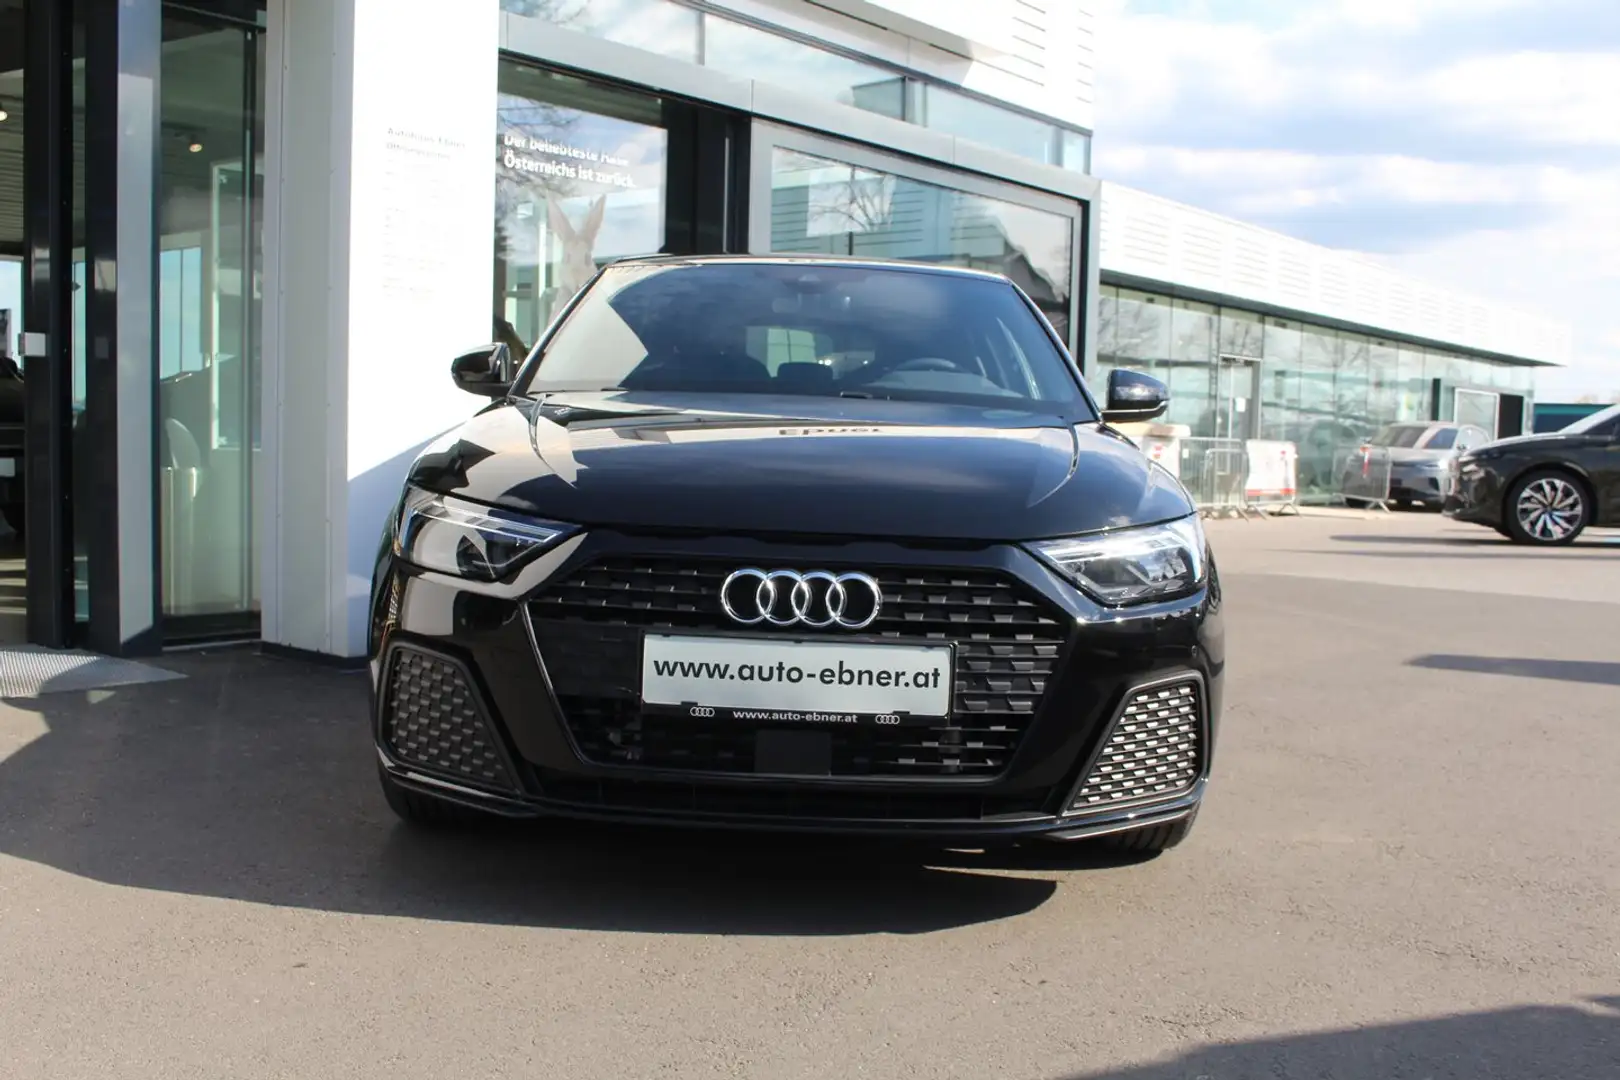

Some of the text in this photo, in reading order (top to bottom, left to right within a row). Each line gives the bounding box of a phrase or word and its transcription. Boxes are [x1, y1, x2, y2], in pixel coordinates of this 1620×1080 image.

[504, 149, 576, 178] Österreichs
[578, 164, 594, 182] ist
[653, 660, 941, 688] www.auto-ebner.at
[732, 710, 858, 723] www.auto-ebner.at
